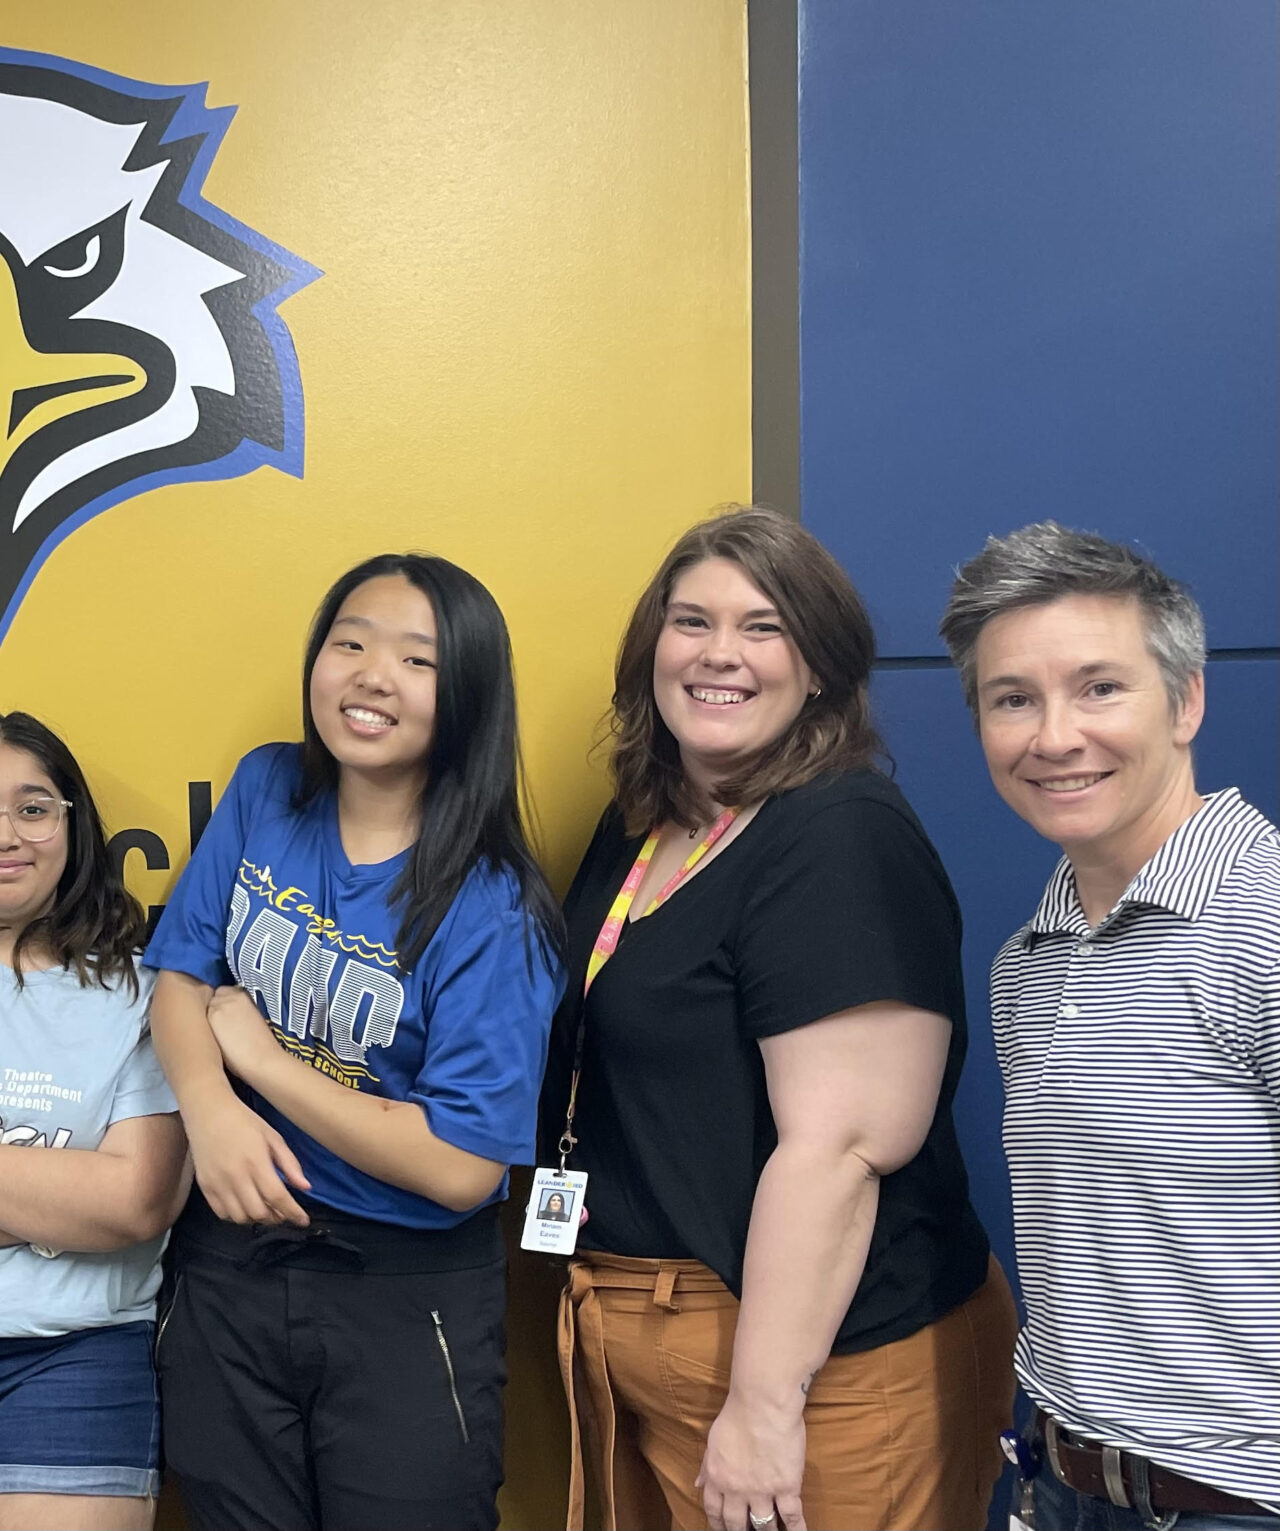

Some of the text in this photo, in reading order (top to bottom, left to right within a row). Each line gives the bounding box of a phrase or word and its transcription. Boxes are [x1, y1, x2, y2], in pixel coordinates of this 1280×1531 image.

[4, 1068, 53, 1082] Theatre
[314, 1056, 360, 1089] SCHOOL
[6, 1081, 82, 1103] Department
